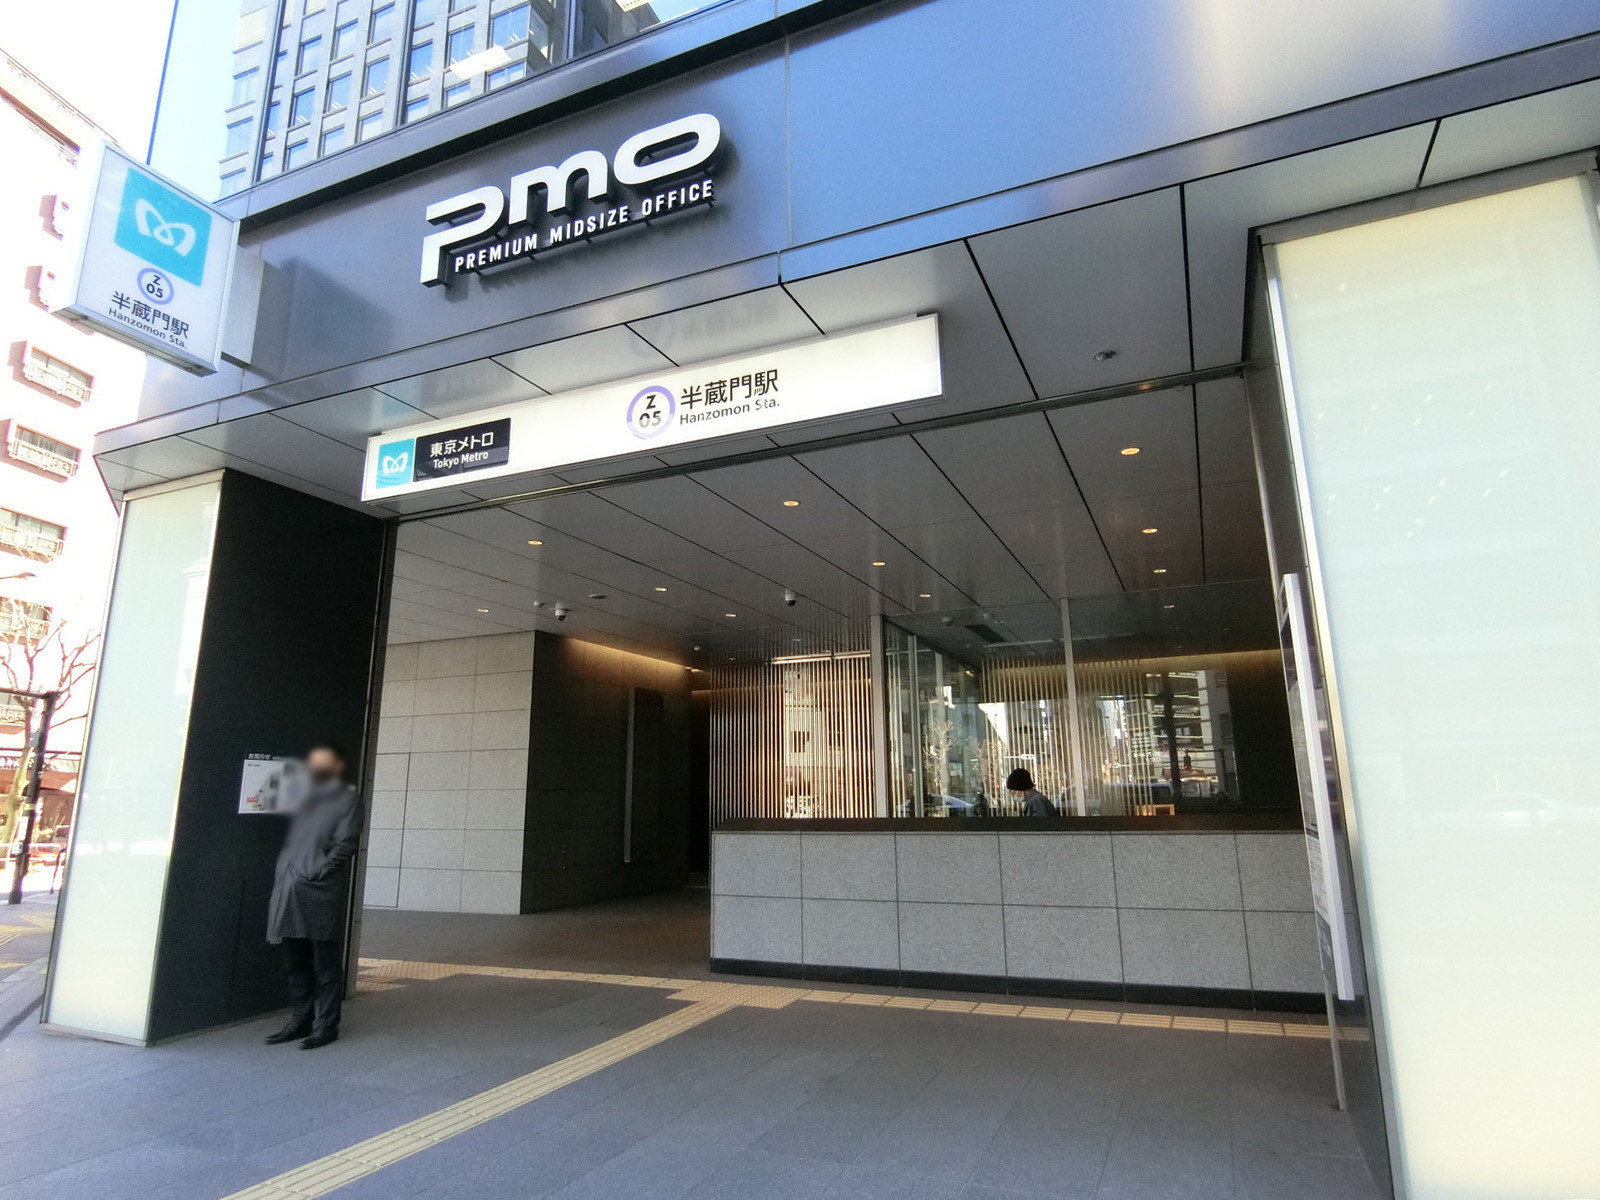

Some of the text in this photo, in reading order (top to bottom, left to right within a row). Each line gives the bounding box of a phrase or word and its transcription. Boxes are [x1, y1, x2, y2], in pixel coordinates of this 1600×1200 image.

[454, 179, 714, 273] PREMIUM MIDSIZE OFFICE
[146, 283, 164, 298] 05
[153, 274, 161, 286] Z
[108, 307, 188, 349] Hanzomon Sta.
[111, 290, 190, 339] 半蔵門駅
[646, 394, 657, 410] Z
[680, 368, 779, 410] 半蔵門駅
[638, 410, 662, 429] 05
[679, 397, 781, 426] Hanzomon Sta.
[429, 431, 494, 458] 東京メトロ
[432, 451, 489, 469] Tokyo Metro
